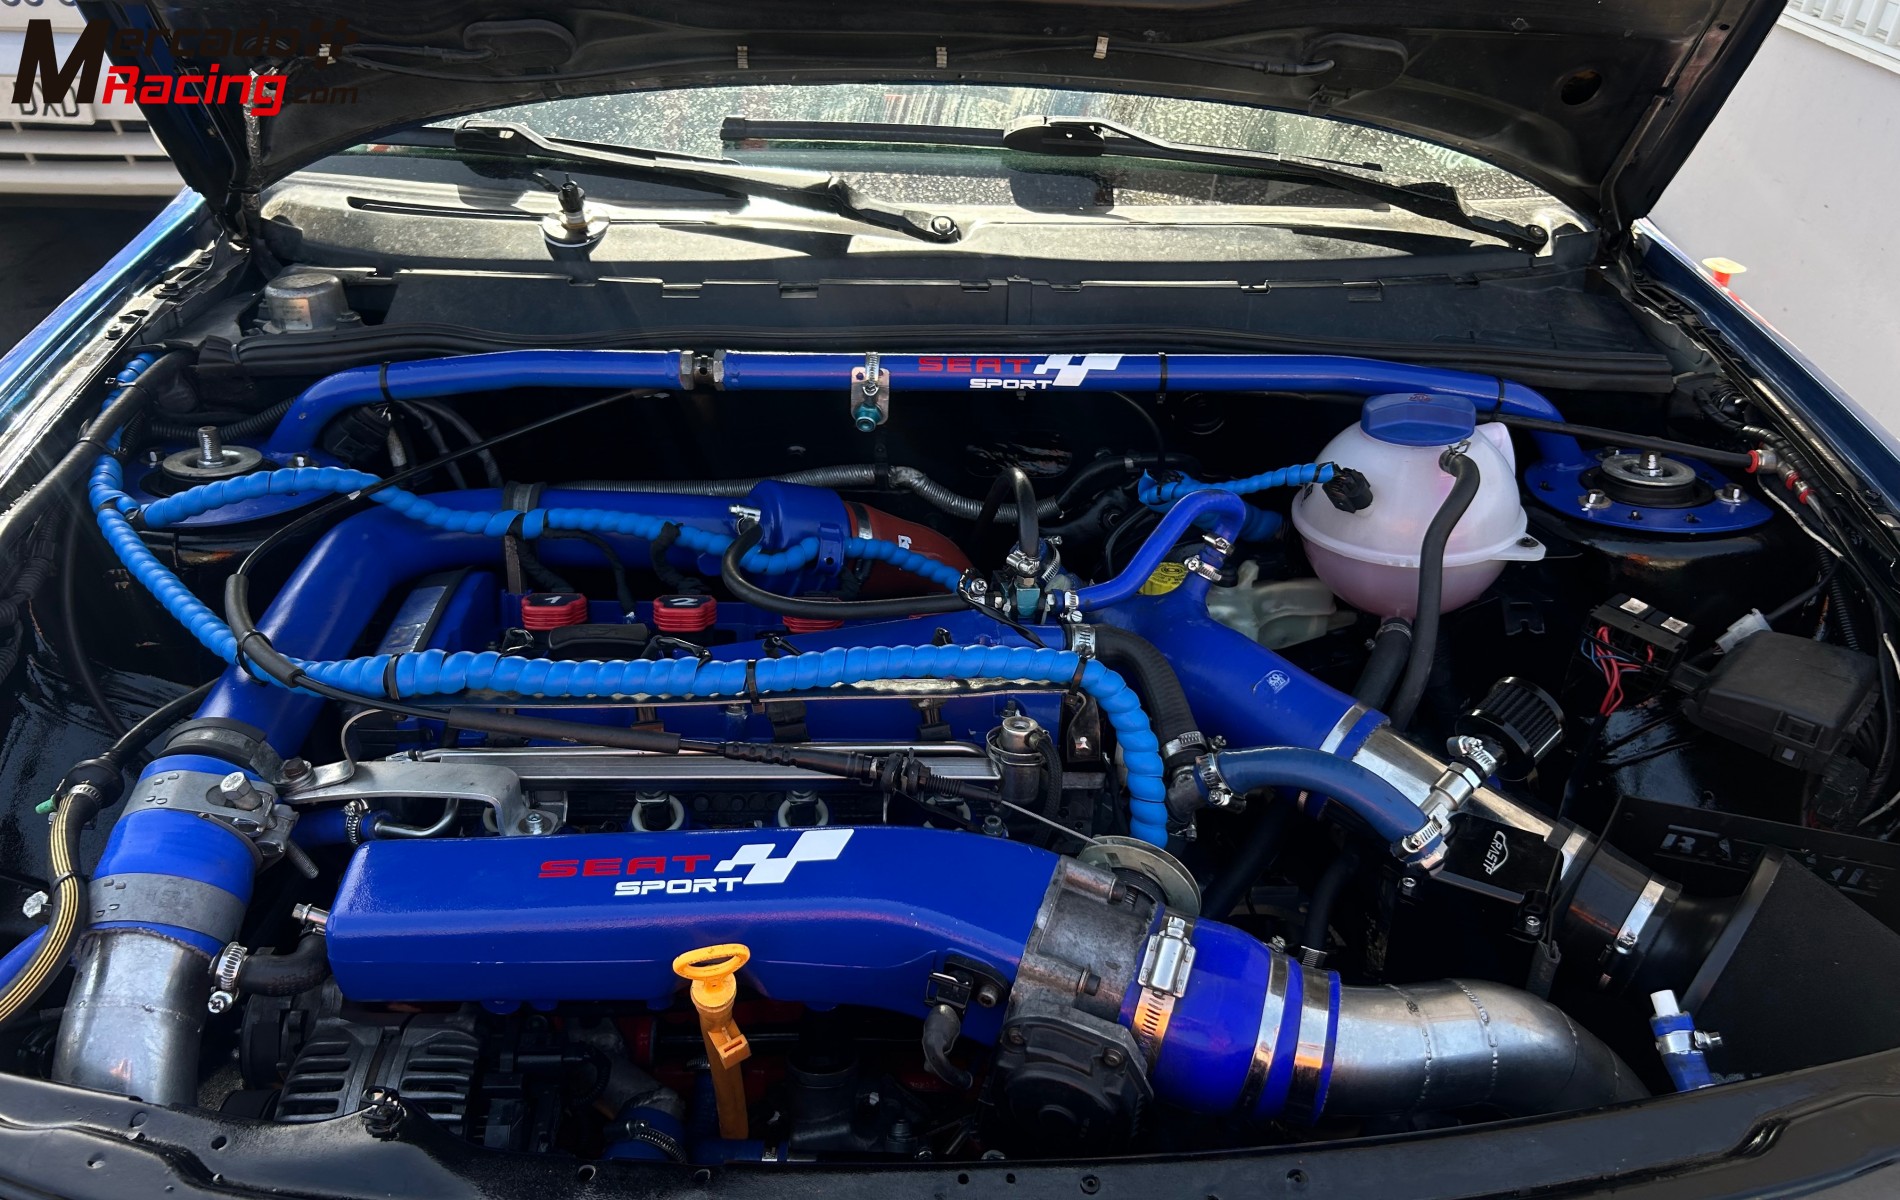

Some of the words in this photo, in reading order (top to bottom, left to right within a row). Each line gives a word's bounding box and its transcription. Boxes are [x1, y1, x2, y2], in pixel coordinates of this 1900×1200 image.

[918, 356, 1030, 374] SEAT
[970, 378, 1053, 390] SPORT
[538, 855, 711, 878] SEAT
[614, 877, 743, 896] SPORT
